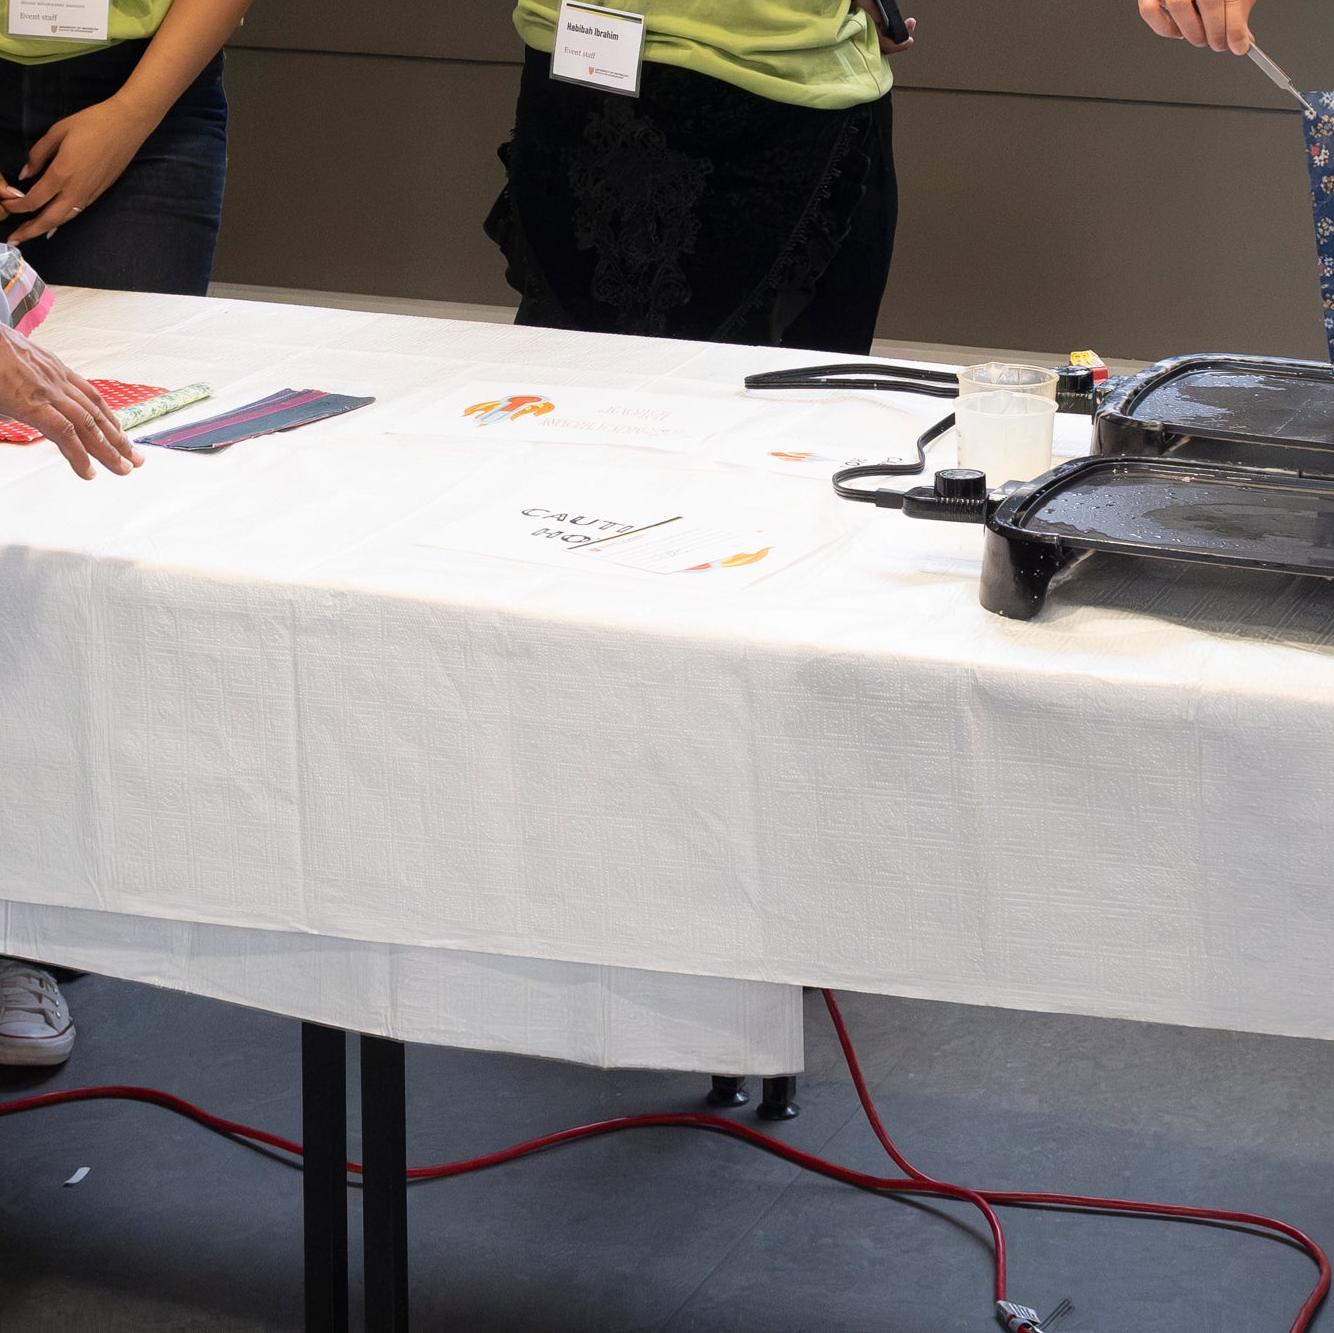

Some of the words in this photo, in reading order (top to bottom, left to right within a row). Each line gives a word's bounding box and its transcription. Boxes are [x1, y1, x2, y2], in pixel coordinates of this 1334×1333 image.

[19, 11, 40, 21] Event
[41, 13, 59, 22] staff
[566, 21, 594, 36] Habibah
[593, 26, 620, 41] Ibrahim
[563, 46, 582, 57] Event
[581, 51, 597, 59] staff
[521, 508, 635, 534] CAUTI
[531, 527, 601, 544] HO
